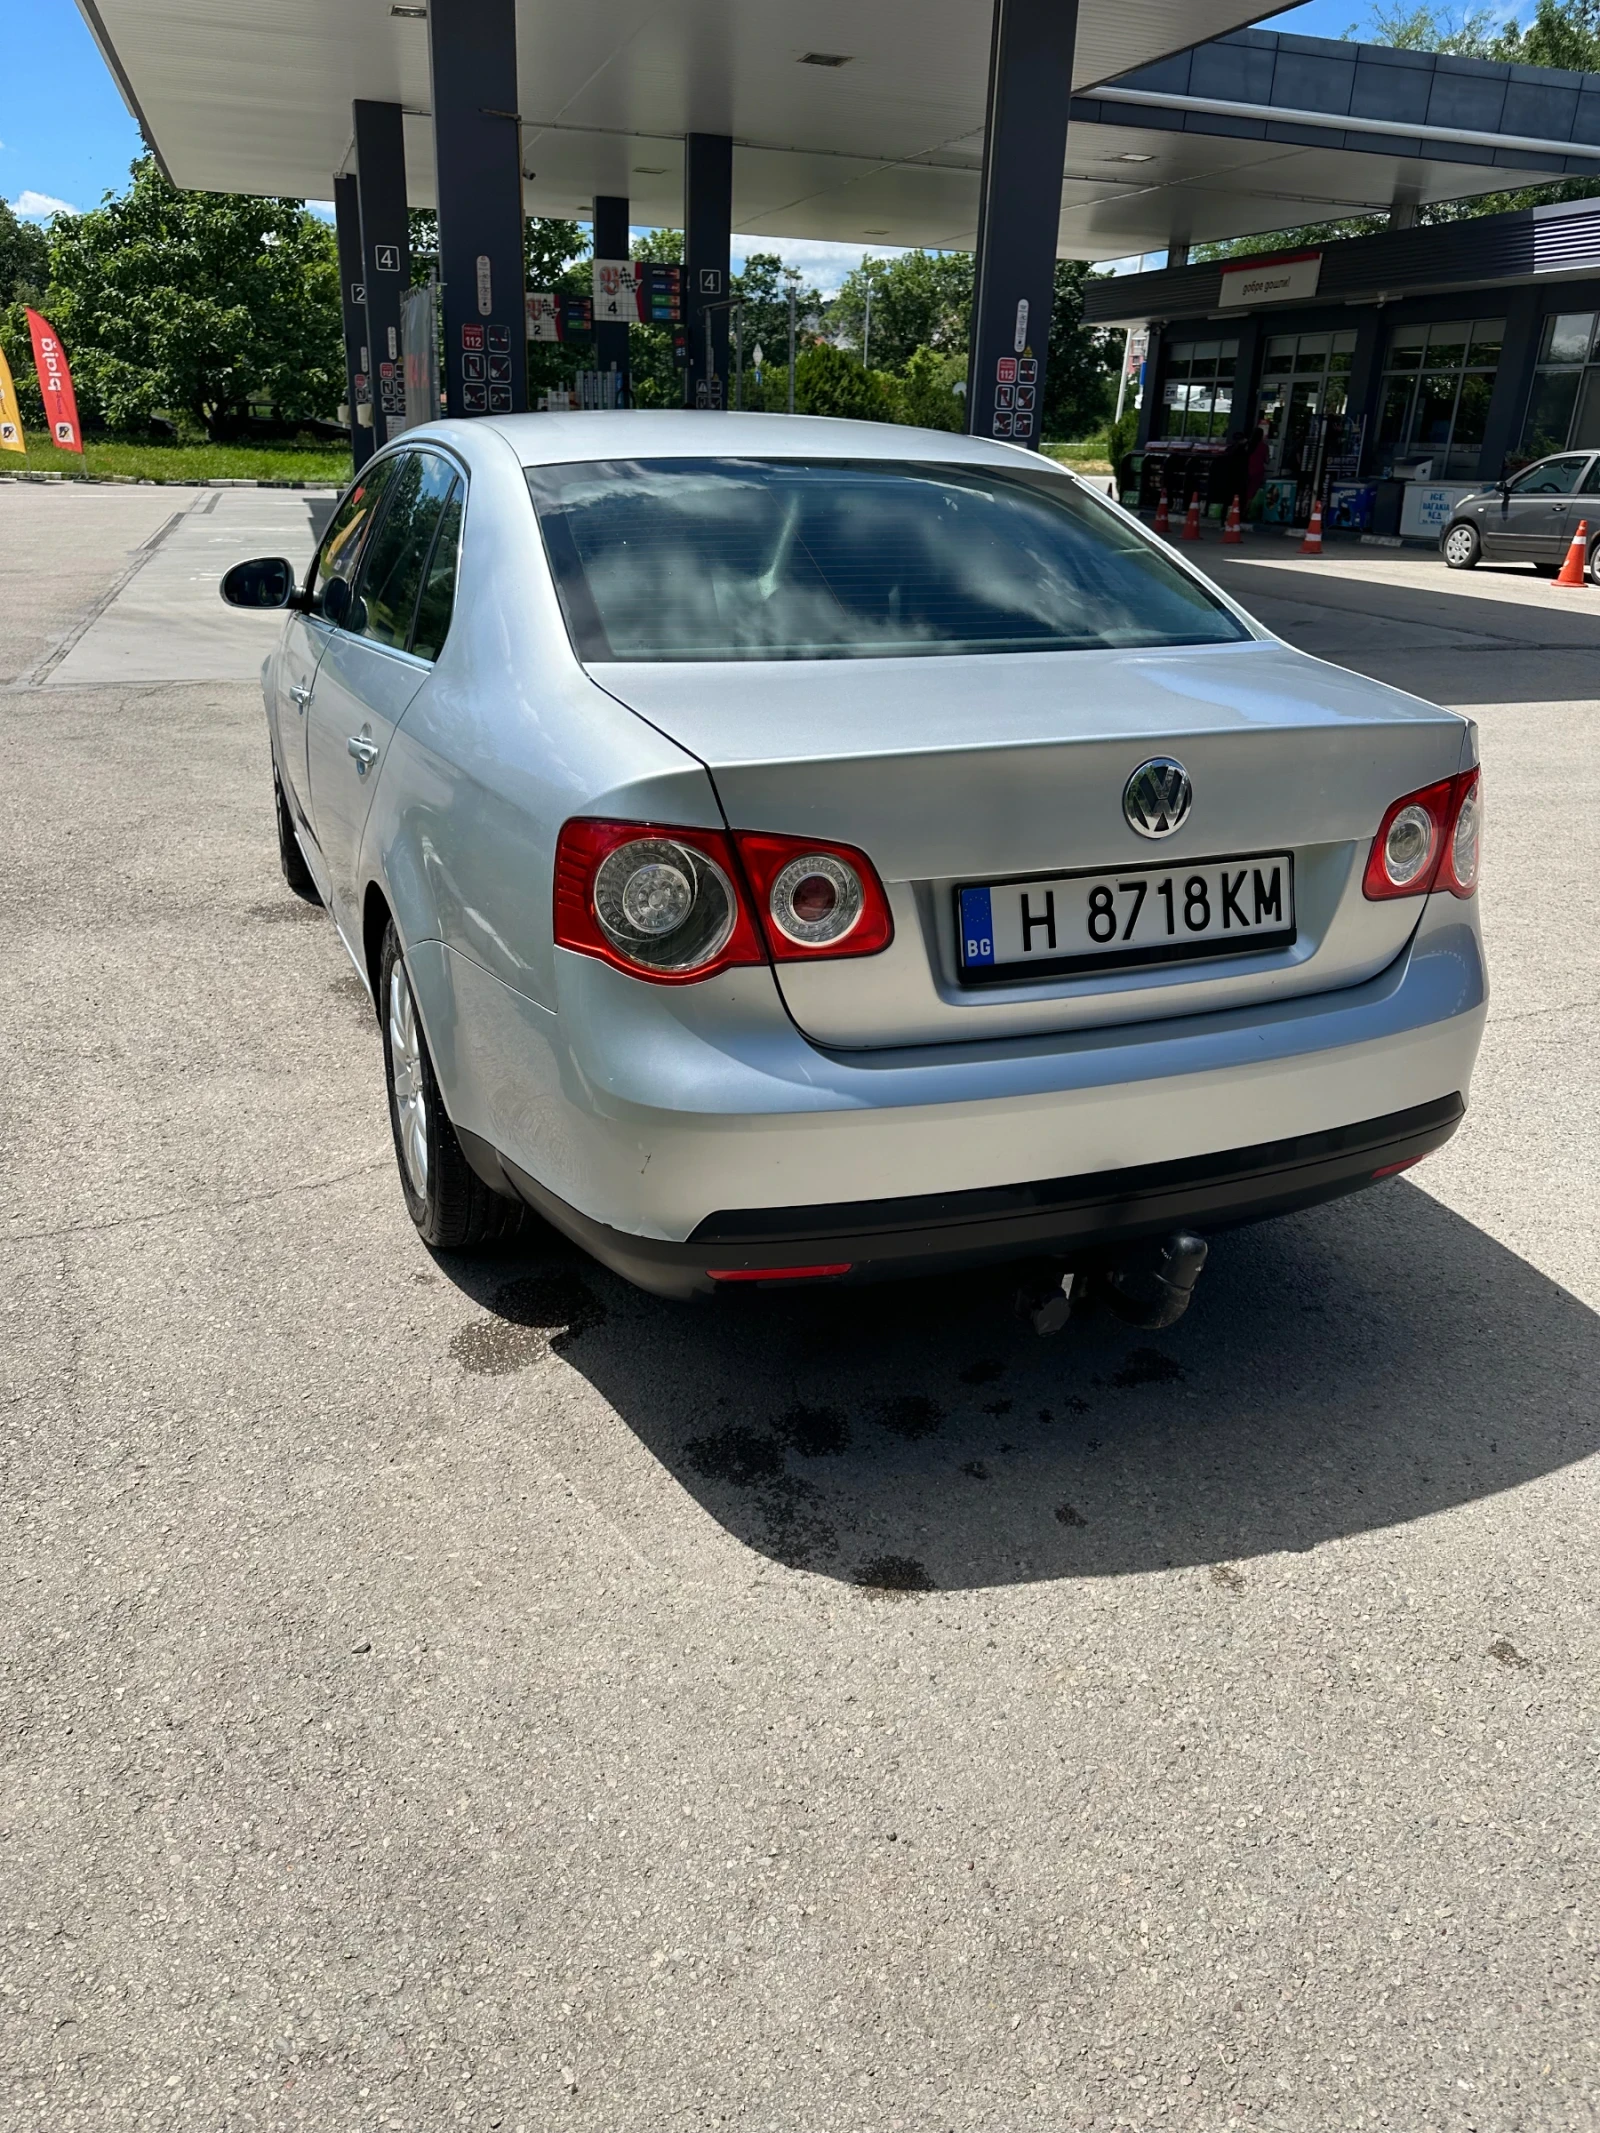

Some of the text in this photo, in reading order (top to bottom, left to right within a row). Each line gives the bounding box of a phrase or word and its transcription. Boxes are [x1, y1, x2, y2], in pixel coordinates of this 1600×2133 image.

[381, 249, 393, 268] 4
[704, 273, 716, 291] 4
[356, 287, 366, 301] 2
[608, 301, 618, 314] 4
[534, 325, 541, 335] 2
[465, 336, 482, 347] 112
[1000, 370, 1014, 380] 112
[1020, 890, 1057, 952] H
[967, 938, 991, 957] BG
